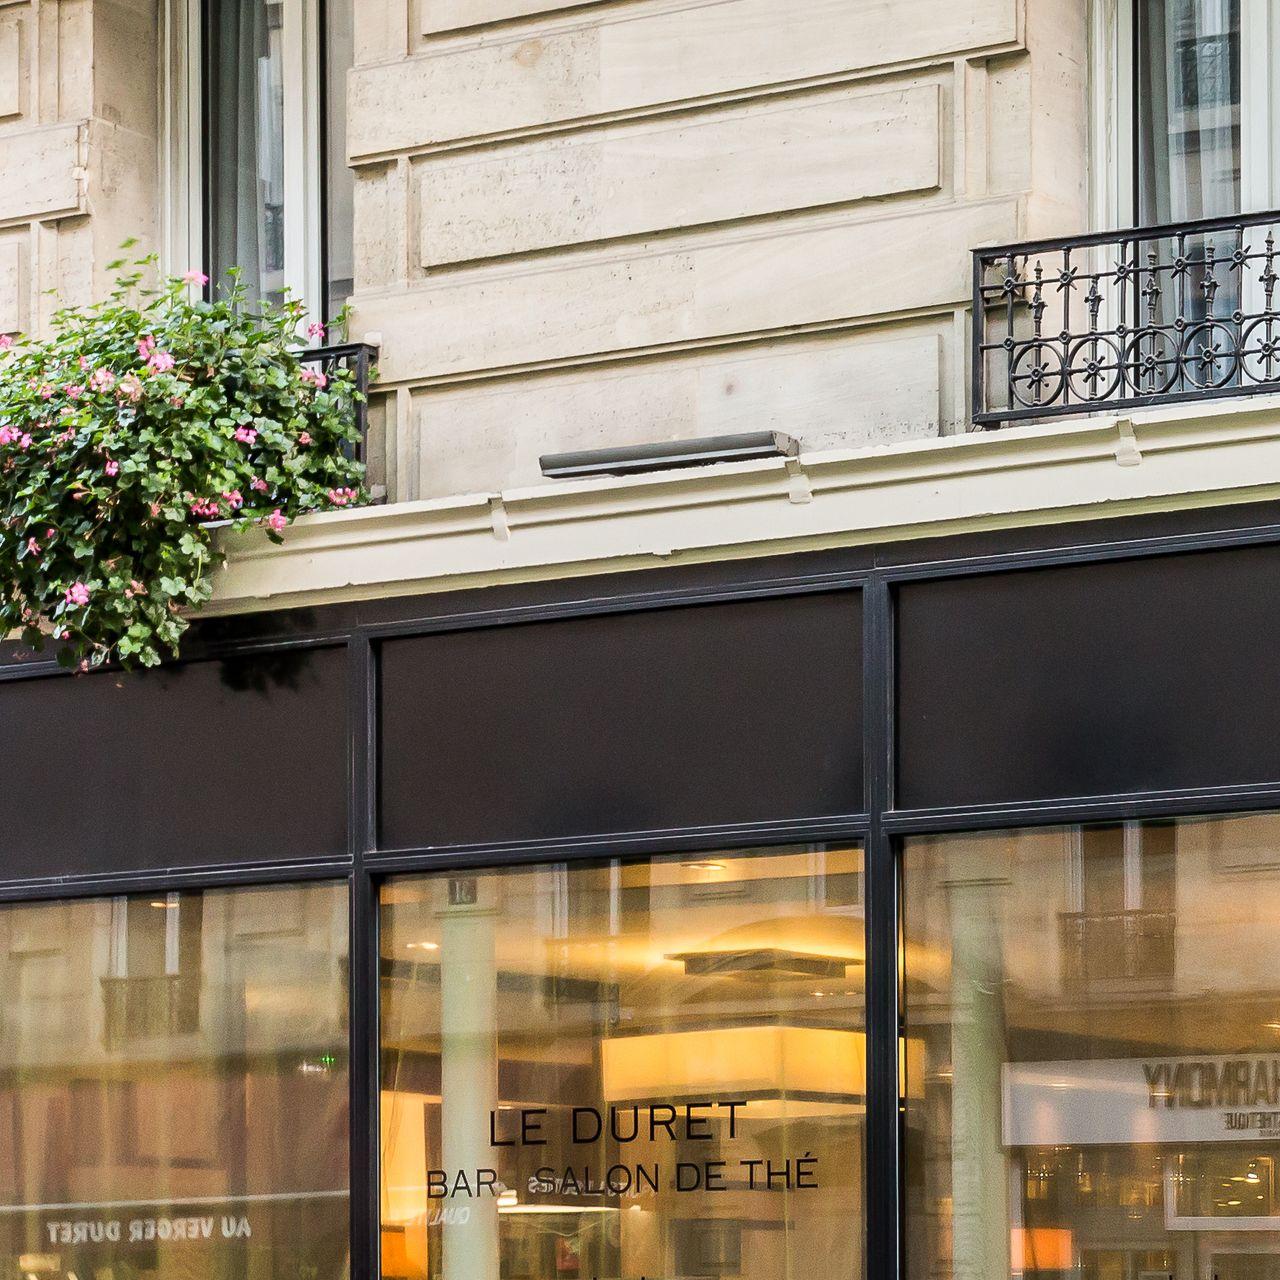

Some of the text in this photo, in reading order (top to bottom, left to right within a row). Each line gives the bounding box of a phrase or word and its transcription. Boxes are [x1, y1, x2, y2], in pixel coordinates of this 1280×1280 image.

[488, 1100, 748, 1148] LE DURET
[427, 1168, 498, 1199] BAR
[534, 1163, 660, 1195] SALON
[676, 1161, 727, 1193] DE
[740, 1152, 820, 1191] THÉ
